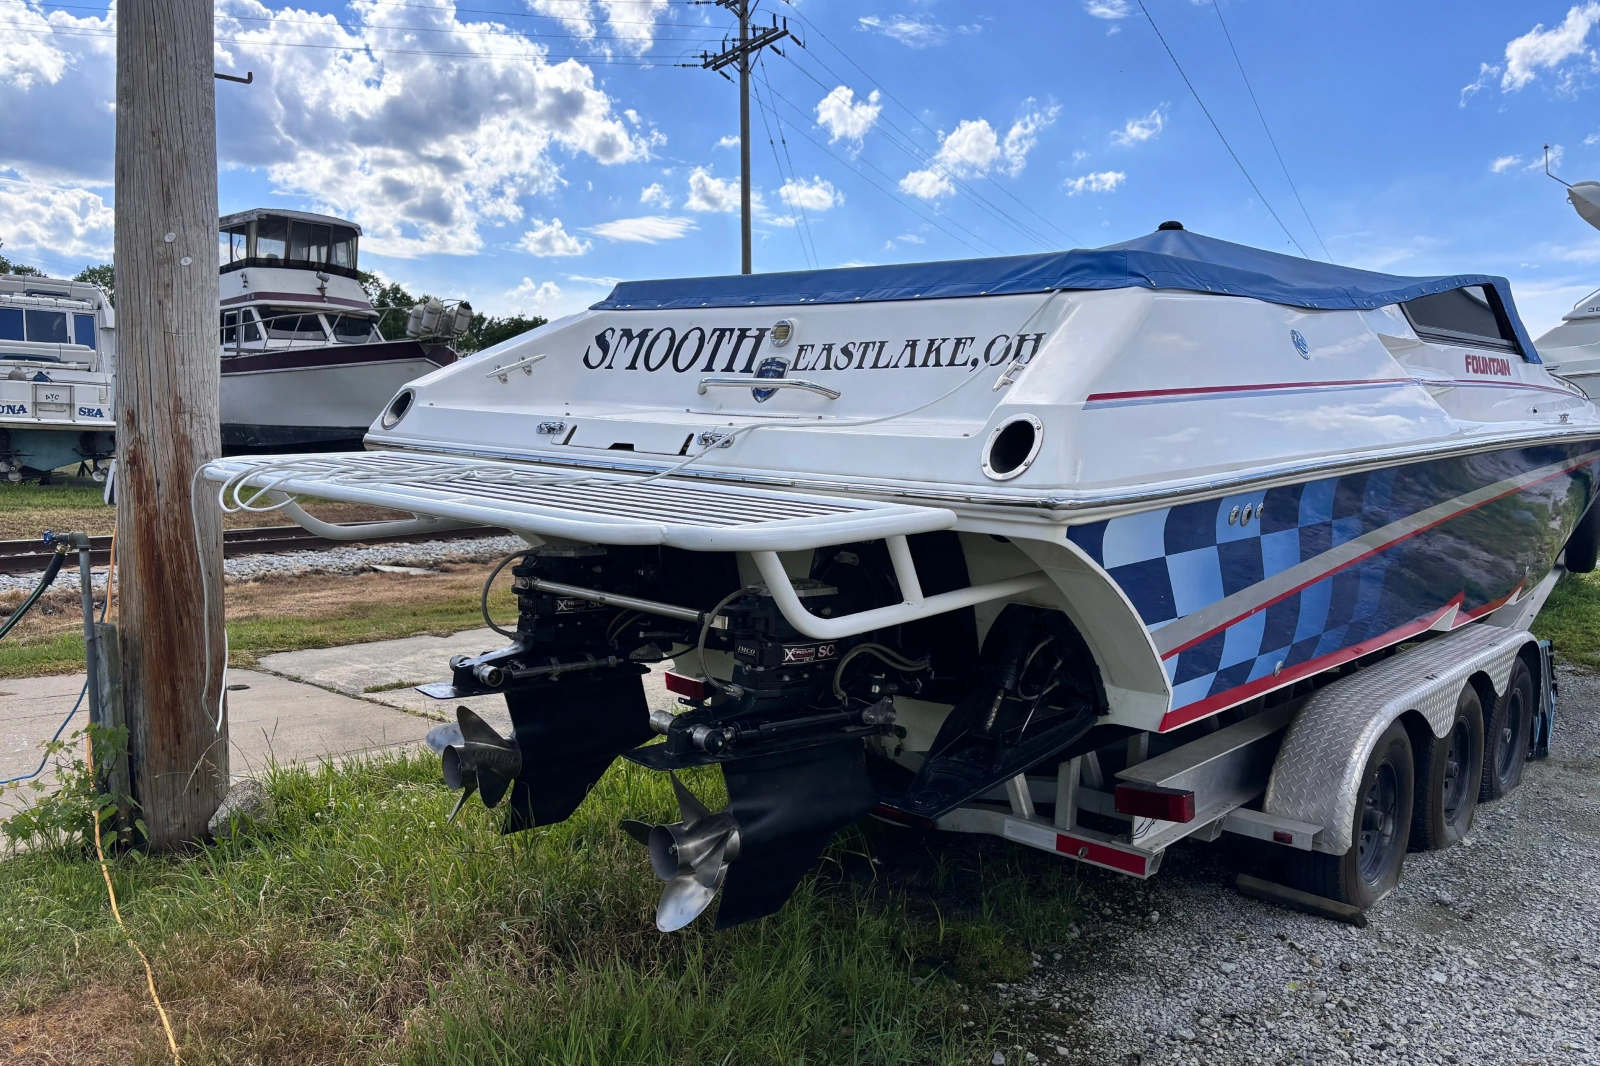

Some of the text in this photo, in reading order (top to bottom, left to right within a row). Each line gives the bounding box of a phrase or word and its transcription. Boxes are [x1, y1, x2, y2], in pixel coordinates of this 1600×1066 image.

[583, 327, 771, 374] SMOOTH
[1464, 354, 1512, 376] FOUNTAIN
[78, 406, 105, 418] SEA
[817, 644, 835, 658] SC
